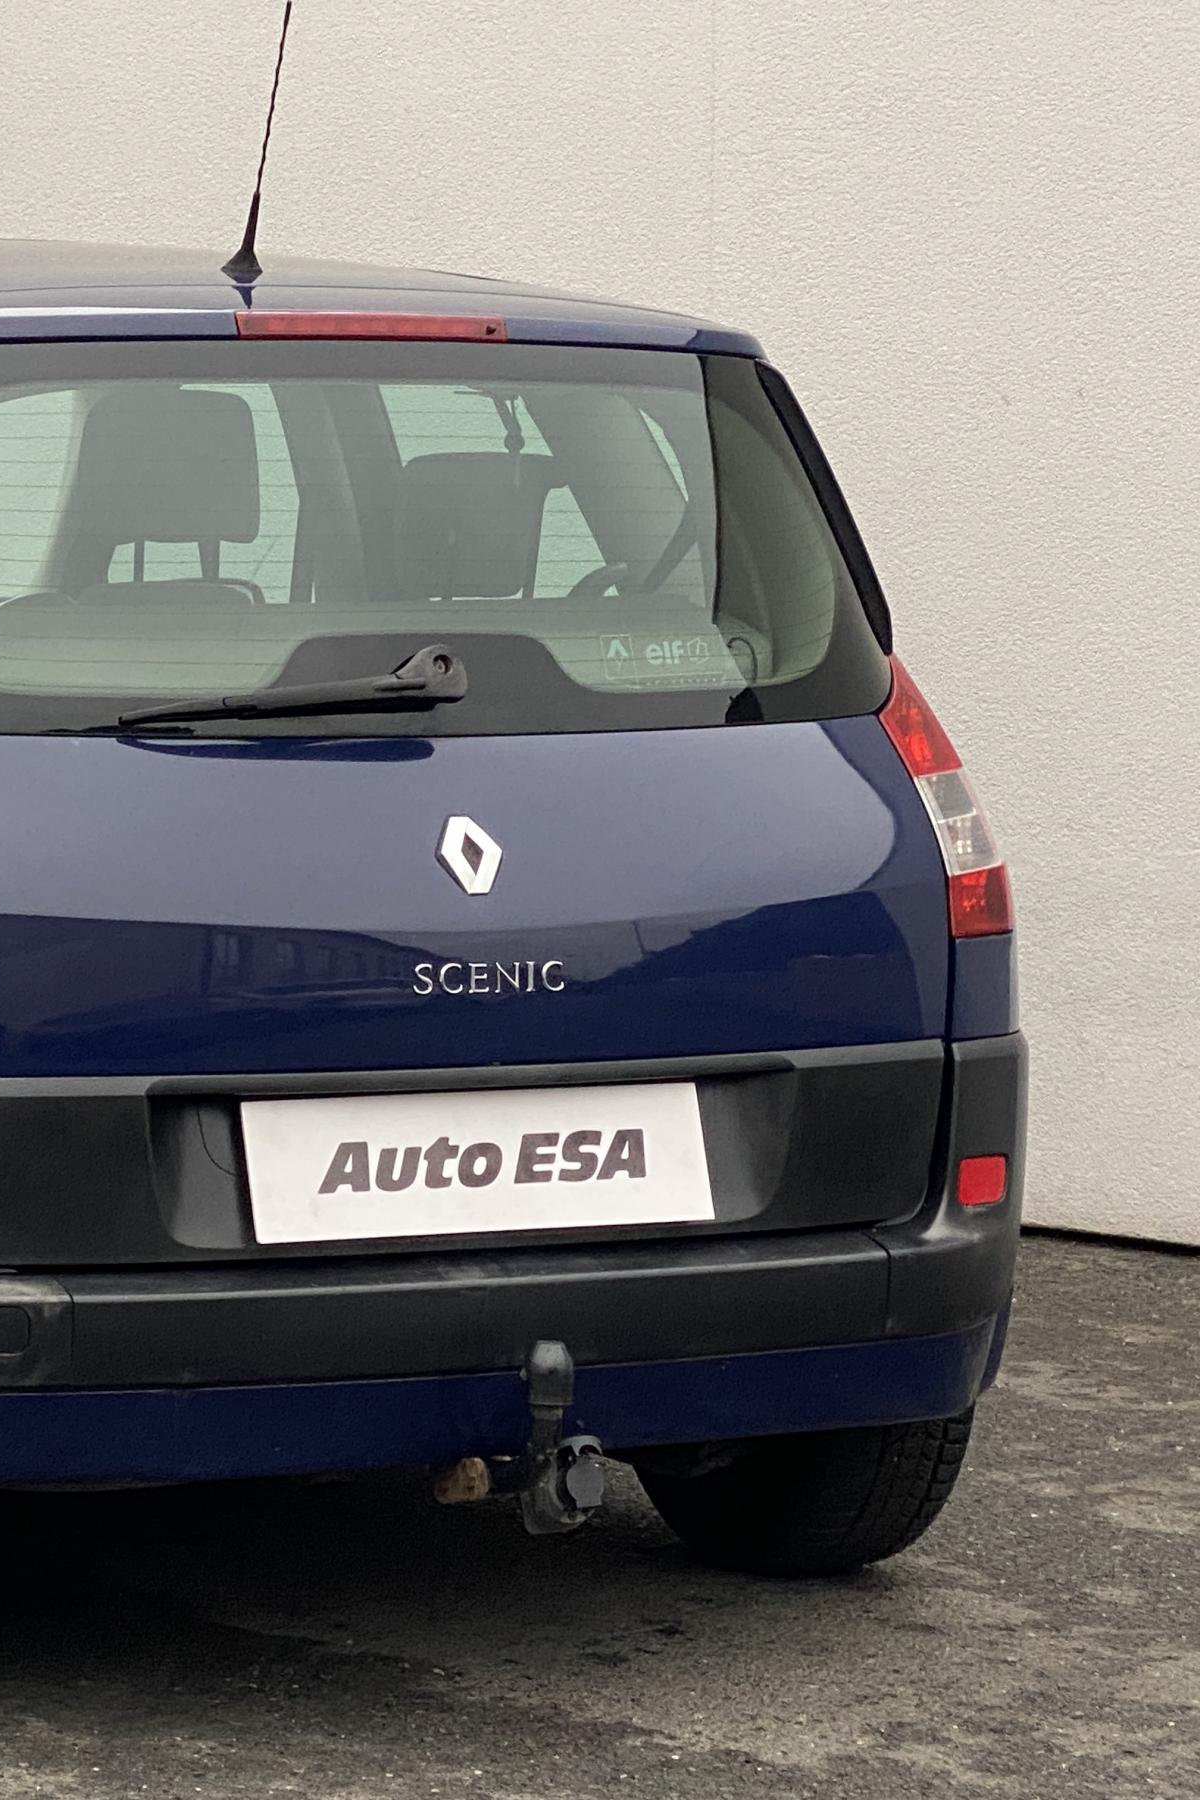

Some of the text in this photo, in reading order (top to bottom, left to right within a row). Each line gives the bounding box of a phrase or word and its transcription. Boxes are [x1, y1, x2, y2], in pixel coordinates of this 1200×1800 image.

[647, 640, 684, 665] elf
[412, 960, 565, 995] SCENIC
[318, 1129, 646, 1194] Auto ESA
